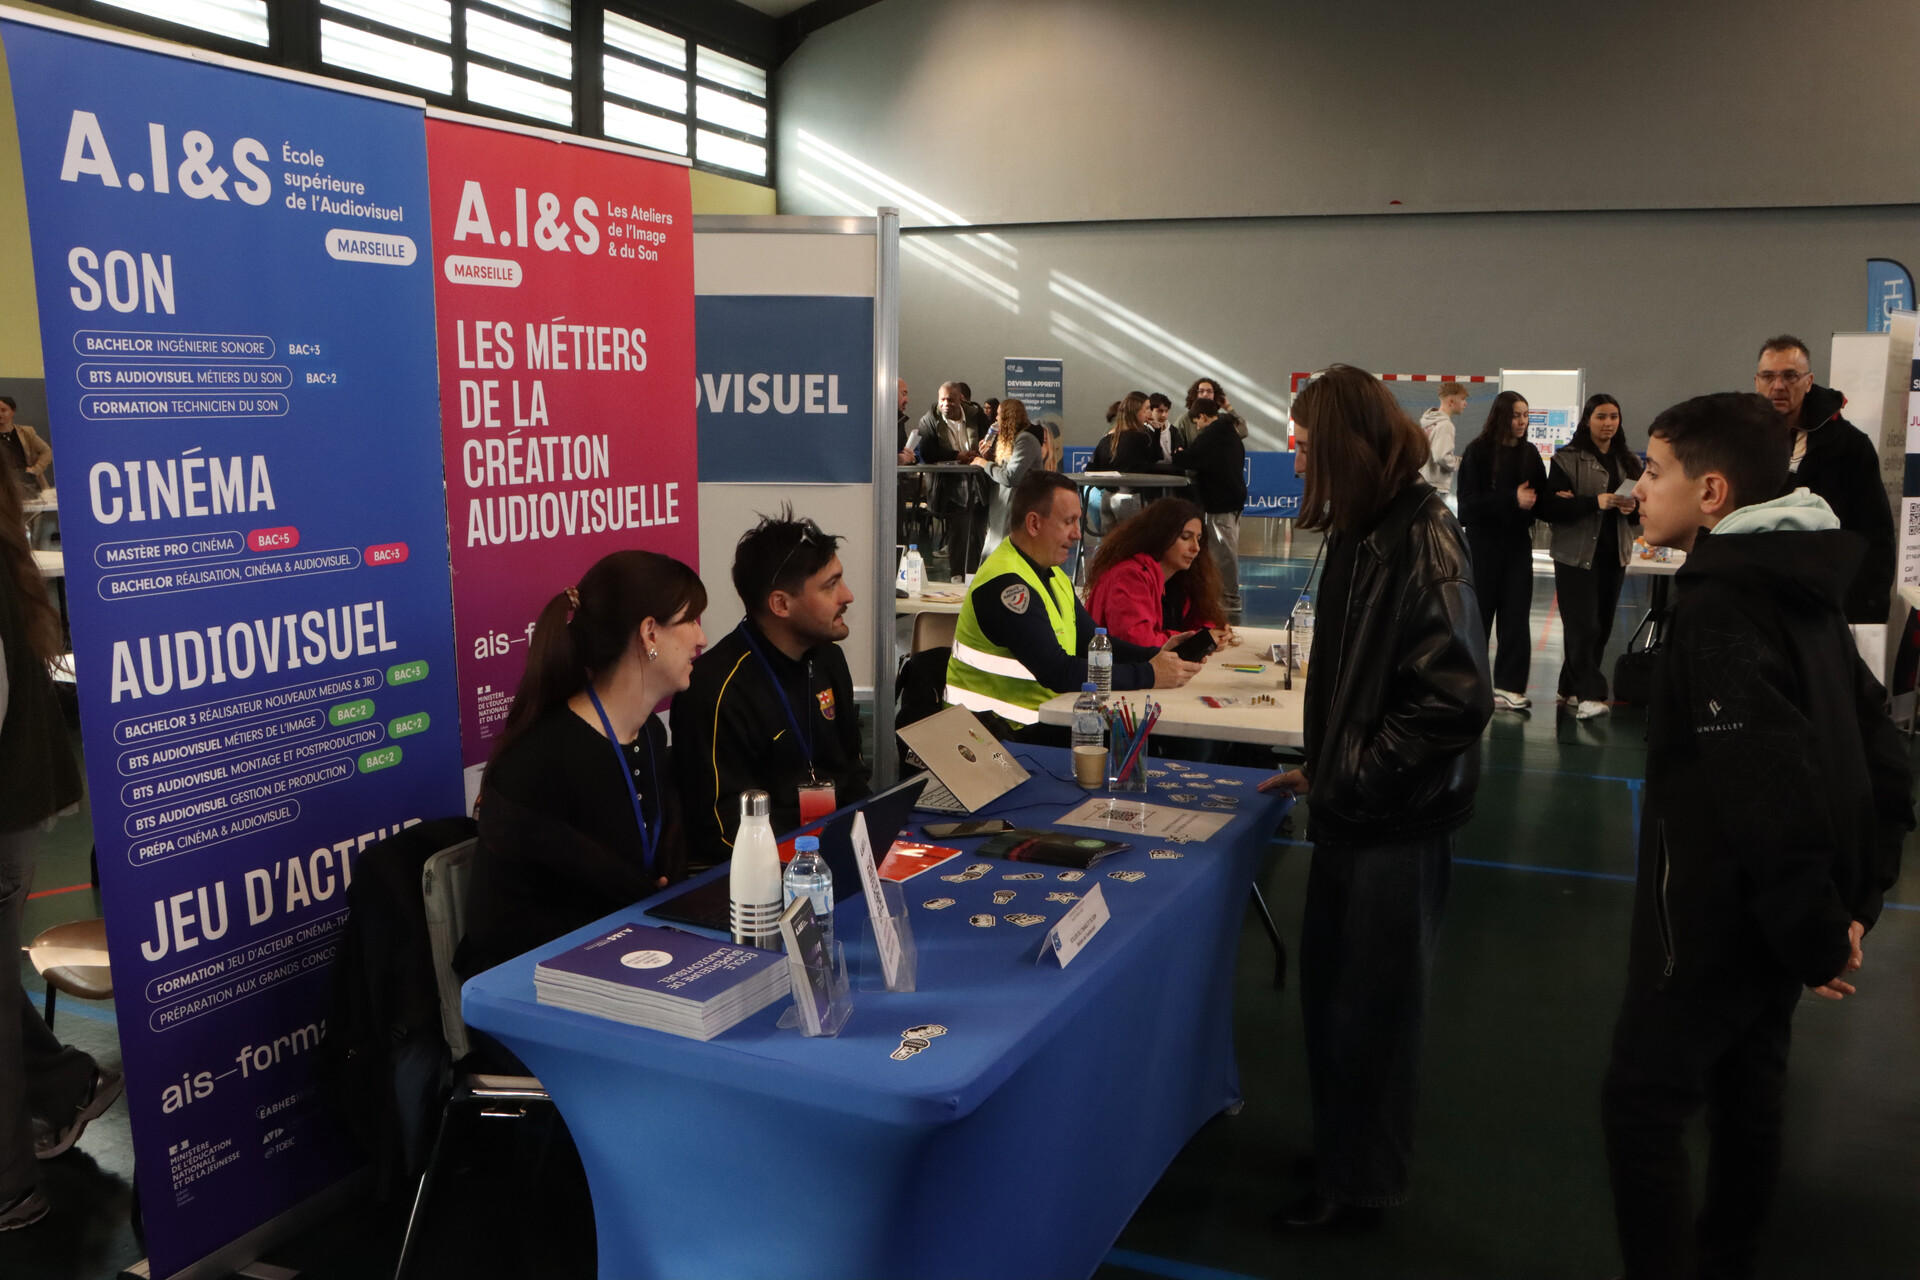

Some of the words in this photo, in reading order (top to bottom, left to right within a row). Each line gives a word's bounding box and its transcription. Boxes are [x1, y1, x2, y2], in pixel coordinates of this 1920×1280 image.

[60, 110, 271, 206] A.I&S
[283, 141, 324, 168] École
[284, 172, 365, 196] supérieure
[286, 194, 306, 211] de
[312, 196, 403, 222] l'Audiovisuel
[454, 180, 600, 256] A.I&S
[608, 202, 628, 219] Les
[631, 205, 673, 225] Ateliers
[338, 238, 405, 258] MARSEILLE
[608, 222, 622, 237] de
[626, 225, 666, 245] l'Image
[608, 243, 617, 257] &
[620, 244, 635, 259] du
[638, 245, 658, 262] Son
[68, 247, 176, 315] SON
[454, 264, 513, 281] MARSEILLE
[86, 338, 153, 352] BACHELOR
[156, 338, 218, 352] INGÉNIERIE
[221, 342, 265, 354] SONORE
[289, 344, 320, 356] BAC+3
[457, 320, 515, 370] LES
[526, 316, 647, 372] MÉTIERS
[90, 371, 112, 383] BTS
[116, 371, 194, 383] AUDIOVISUEL
[197, 369, 240, 384] MÉTIERS
[244, 372, 258, 383] DU
[261, 372, 282, 384] SON
[306, 373, 337, 384] BAC+2
[93, 401, 168, 414] FORMATION
[171, 400, 236, 412] TECHNICIEN
[239, 400, 254, 412] DU
[257, 400, 278, 411] SON
[460, 380, 501, 428] DE
[512, 380, 549, 427] LA
[463, 428, 610, 488] CRÉATION
[89, 446, 276, 524] CINÉMA
[467, 482, 679, 548] AUDIOVISUELLE
[1244, 496, 1298, 508] LAUCH
[106, 544, 160, 562] MASTÈRE
[164, 543, 188, 556] PRO
[192, 537, 234, 553] CINÉMA
[258, 533, 290, 547] BAC+5
[111, 576, 173, 594] BACHELOR
[244, 560, 282, 578] CINÉMA
[284, 560, 291, 572] &
[294, 554, 351, 571] AUDIOVISUEL
[373, 548, 400, 561] BAC+3
[111, 600, 397, 703] AUDIOVISUEL
[125, 716, 187, 738] BACHELOR
[189, 714, 196, 725] 3
[199, 699, 263, 723] RÉALISATEUR
[265, 688, 317, 708] NOUVEAUX
[319, 681, 352, 696] MEDIAS
[354, 678, 361, 689] &
[362, 676, 375, 688] JRI
[394, 667, 421, 680] BAC+3
[478, 691, 504, 703] MINISTÈRE
[479, 705, 508, 717] NATIONALE
[129, 754, 150, 770] BTS
[152, 737, 222, 764] AUDIOVISUEL
[224, 725, 264, 748] MÉTIERS
[266, 724, 278, 736] DE
[281, 716, 316, 734] L'IMAGE
[337, 705, 366, 720] BAC+2
[133, 785, 154, 800] BTS
[157, 767, 228, 794] AUDIOVISUEL
[230, 753, 282, 775] MONTAGE
[283, 750, 294, 762] ET
[296, 729, 376, 758] POSTPRODUCTION
[396, 718, 422, 734] BAC+2
[136, 816, 157, 831] BTS
[159, 797, 229, 825] AUDIOVISUEL
[230, 785, 272, 806] GESTION
[274, 782, 287, 795] DE
[288, 765, 346, 789] PRODUCTION
[366, 752, 394, 769] BAC+2
[139, 840, 175, 859] PRÉPA
[177, 828, 219, 849] CINÉMA
[221, 824, 228, 835] &
[230, 806, 291, 834] AUDIOVISUEL
[141, 880, 228, 962] JEU
[244, 818, 422, 926] D'ACT
[156, 962, 224, 996] FORMATION
[226, 954, 245, 970] JEU
[248, 935, 294, 962] D'ACTEUR
[296, 912, 350, 942] CINÉMA-TH
[722, 952, 758, 971] ÉCOLE
[160, 988, 233, 1026] PRÉPARATION
[236, 978, 257, 996] AUX
[259, 961, 299, 986] GRANDS
[667, 978, 686, 990] DE
[260, 1095, 296, 1120] EABHES
[170, 1141, 210, 1165] MINISTÈRE
[172, 1164, 182, 1174] DE
[184, 1138, 232, 1170] L'ÉDUCATION
[275, 1136, 296, 1154] TOEIC
[173, 1155, 216, 1182] NATIONALE
[174, 1180, 182, 1190] ET
[185, 1174, 195, 1185] DE
[196, 1168, 207, 1180] LA
[207, 1151, 240, 1175] JEUNESSE
